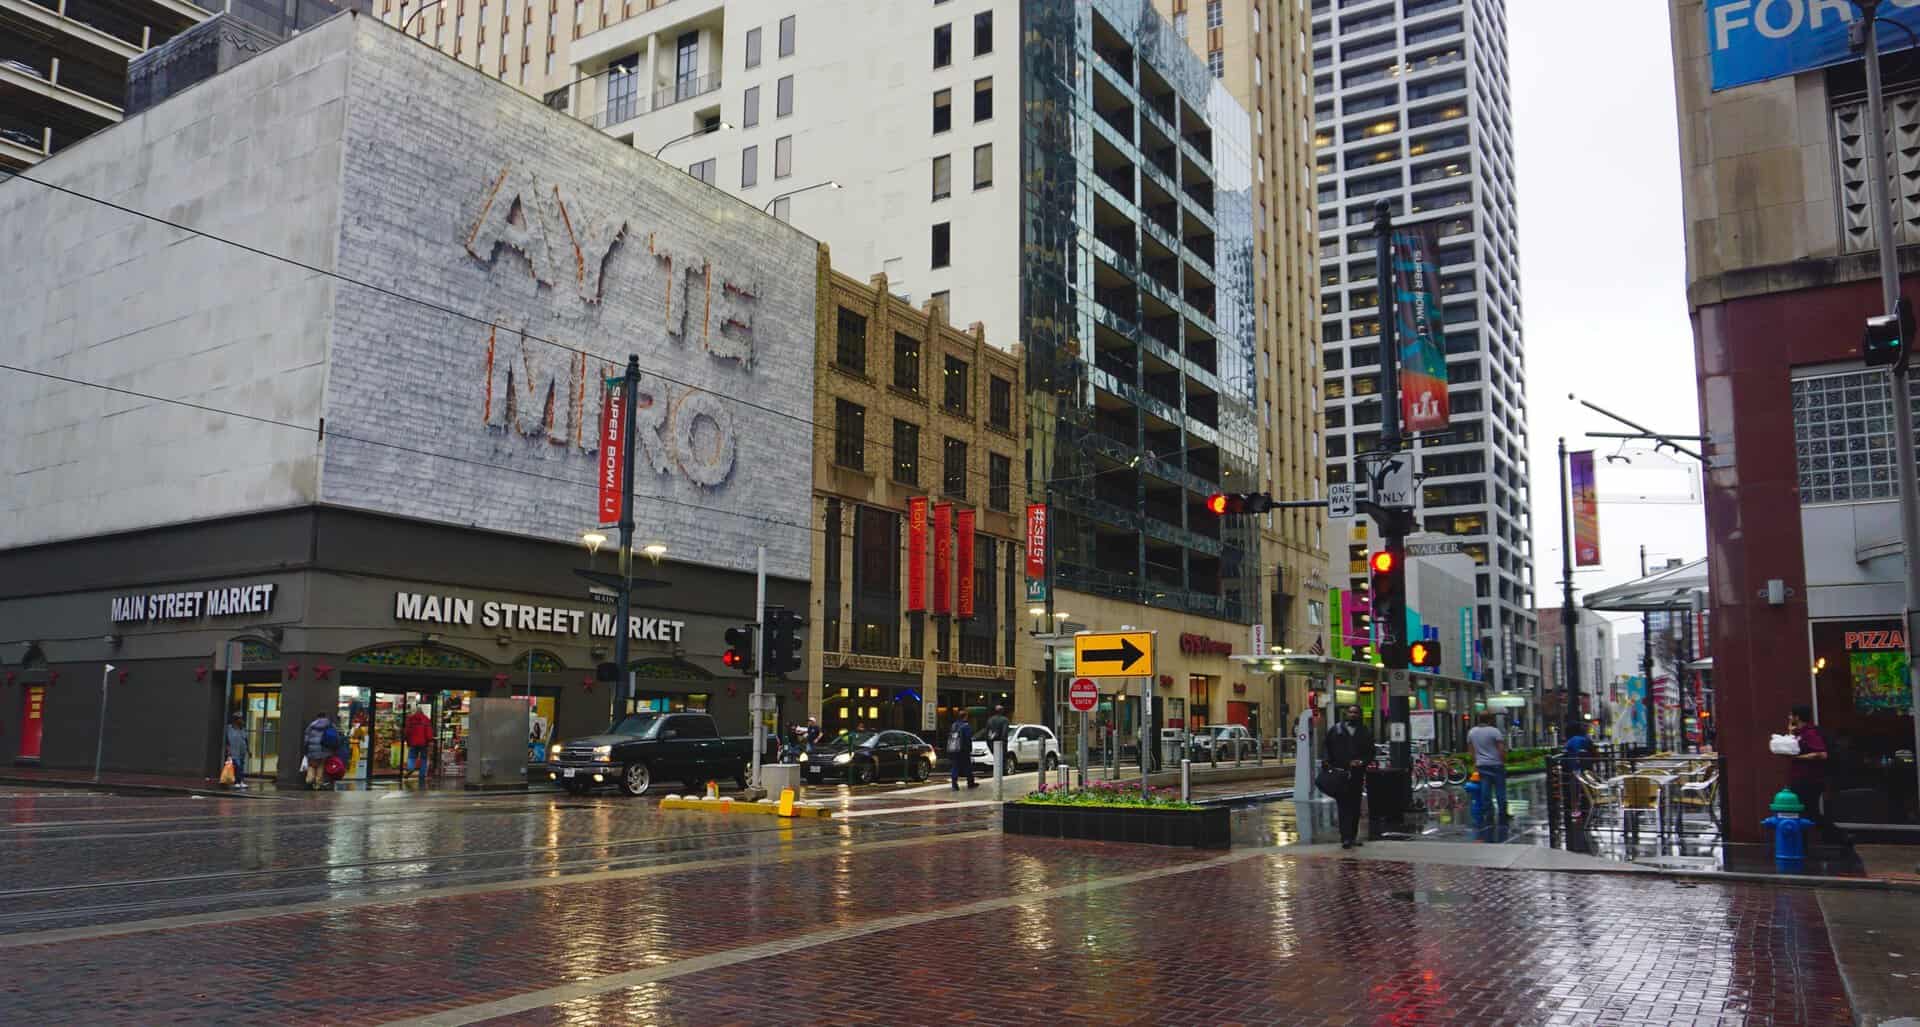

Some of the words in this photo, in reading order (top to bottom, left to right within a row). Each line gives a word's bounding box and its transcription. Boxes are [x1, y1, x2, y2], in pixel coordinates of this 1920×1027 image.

[608, 386, 621, 441] SUPER
[605, 446, 616, 494] BOWL
[604, 498, 615, 513] LI
[1331, 485, 1353, 494] ONE
[1331, 495, 1352, 504] WAY
[912, 501, 925, 534] Holy
[1033, 509, 1045, 565] #SB51
[1408, 543, 1460, 553] WALKER
[111, 597, 145, 622] MAIN
[149, 591, 203, 620] STREET
[206, 583, 273, 616] MARKET
[395, 592, 474, 625] MAIN
[482, 601, 584, 634] STREET
[1844, 630, 1905, 649] PIZZA
